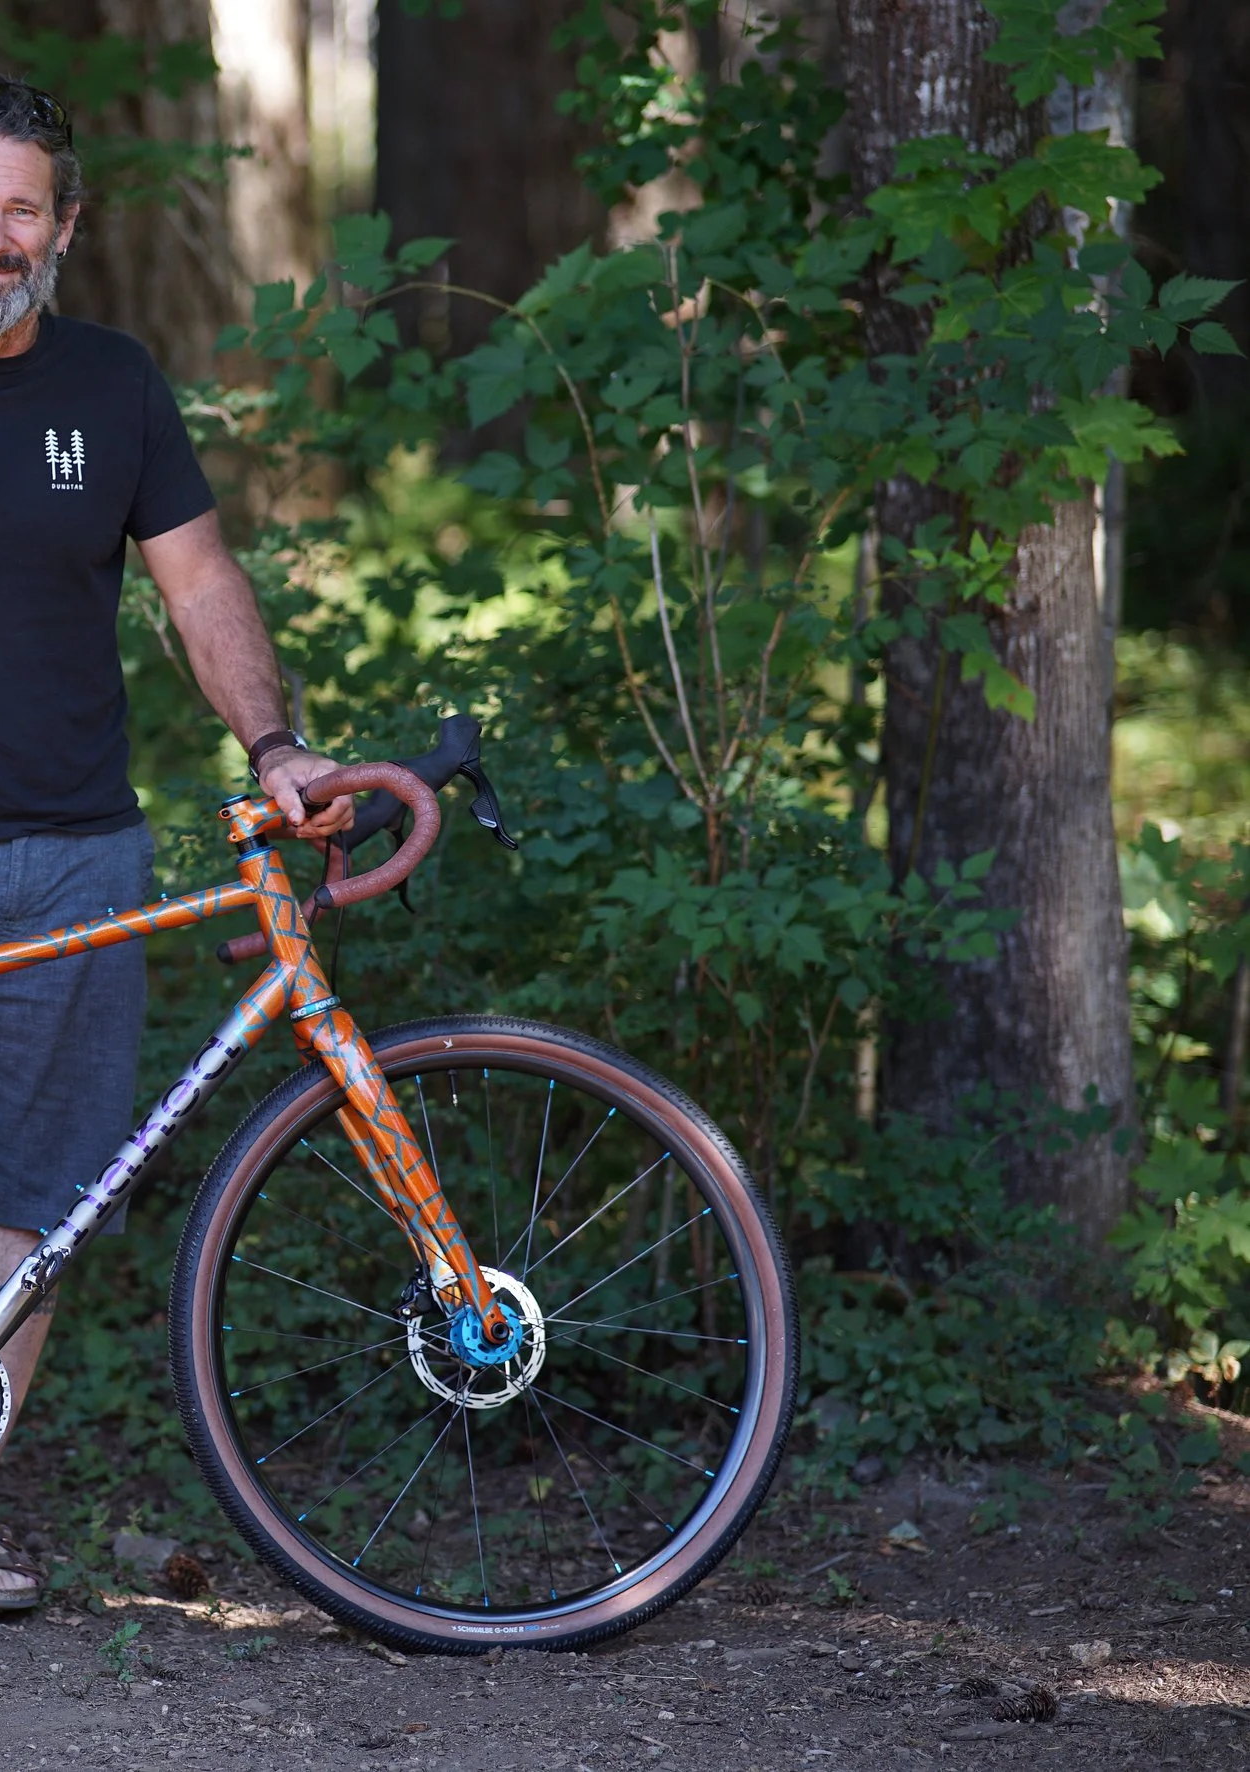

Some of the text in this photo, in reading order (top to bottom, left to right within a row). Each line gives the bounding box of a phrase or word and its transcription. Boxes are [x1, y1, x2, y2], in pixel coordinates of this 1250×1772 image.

[315, 997, 335, 1010] KING
[53, 1035, 242, 1247] naked
[457, 1625, 493, 1634] SCHWALBE
